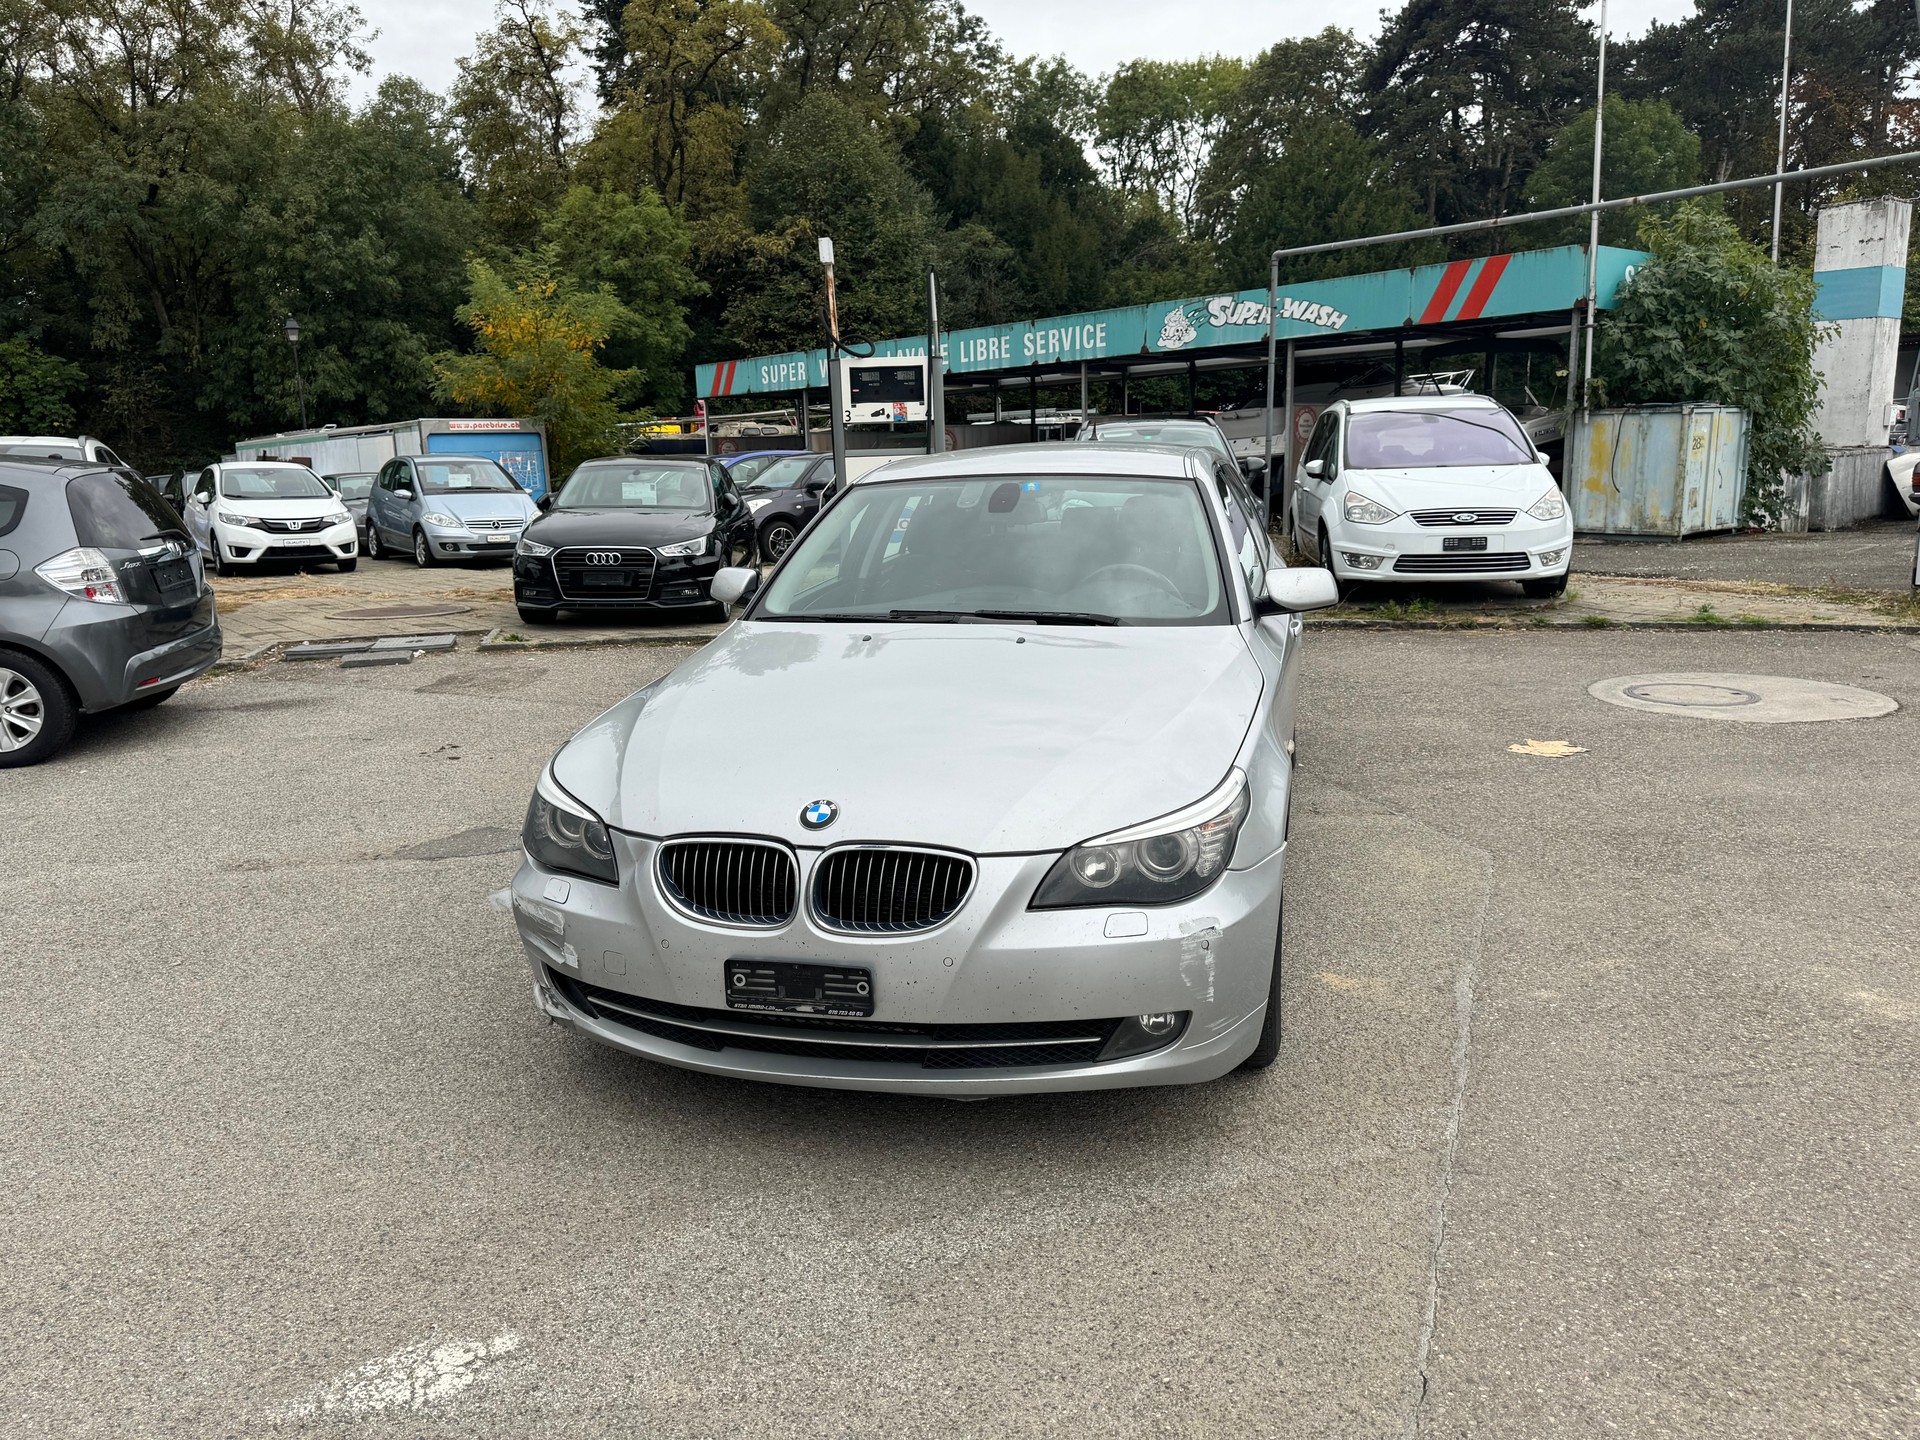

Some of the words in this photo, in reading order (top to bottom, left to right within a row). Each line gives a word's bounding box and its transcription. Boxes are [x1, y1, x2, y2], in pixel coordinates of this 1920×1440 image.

[1206, 296, 1271, 327] SUPER
[1280, 297, 1348, 331] WASH
[761, 361, 806, 385] SUPER
[960, 335, 1010, 363] LIBRE
[1023, 322, 1107, 357] SERVICE
[449, 422, 520, 430] www.parebrise.ch
[845, 410, 851, 422] 3
